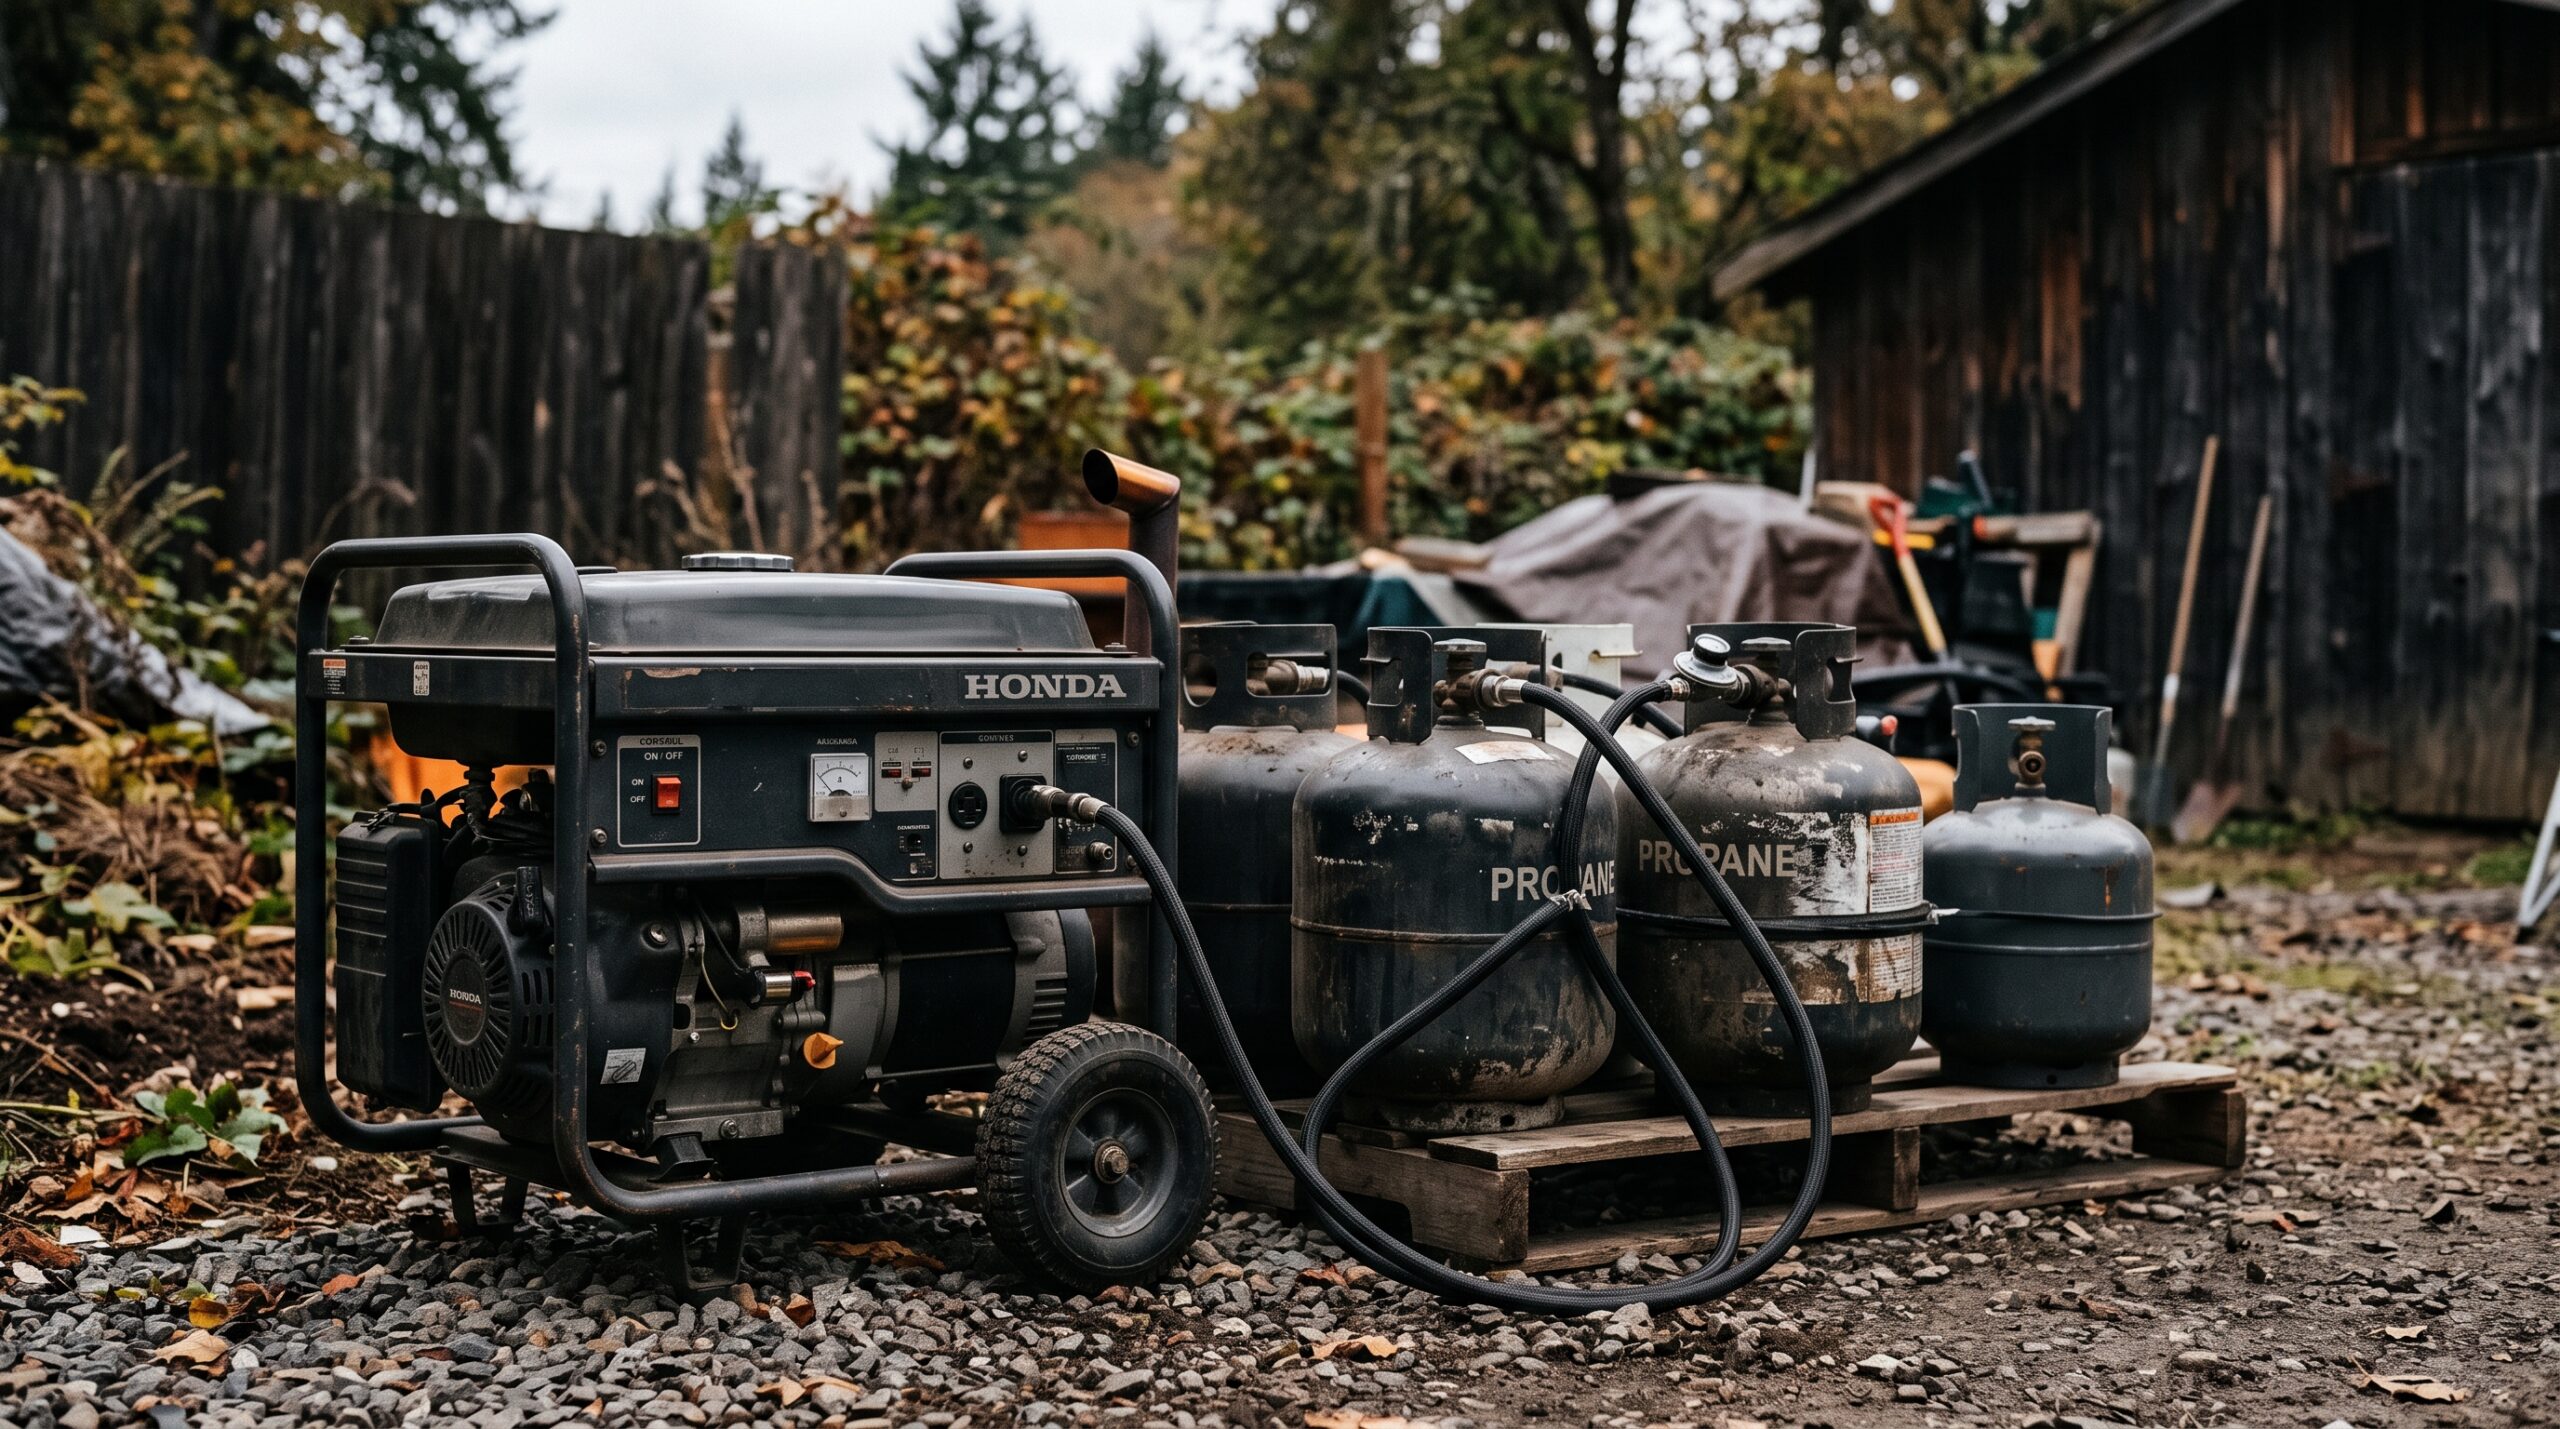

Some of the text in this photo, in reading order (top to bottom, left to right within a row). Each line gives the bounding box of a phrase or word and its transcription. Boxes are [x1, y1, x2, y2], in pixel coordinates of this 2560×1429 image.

[964, 673, 1127, 700] HONDA
[644, 752, 659, 761] ON
[665, 751, 684, 760] OFF
[631, 778, 645, 786] ON
[630, 795, 646, 803] OFF
[1491, 860, 1615, 902] PROANE
